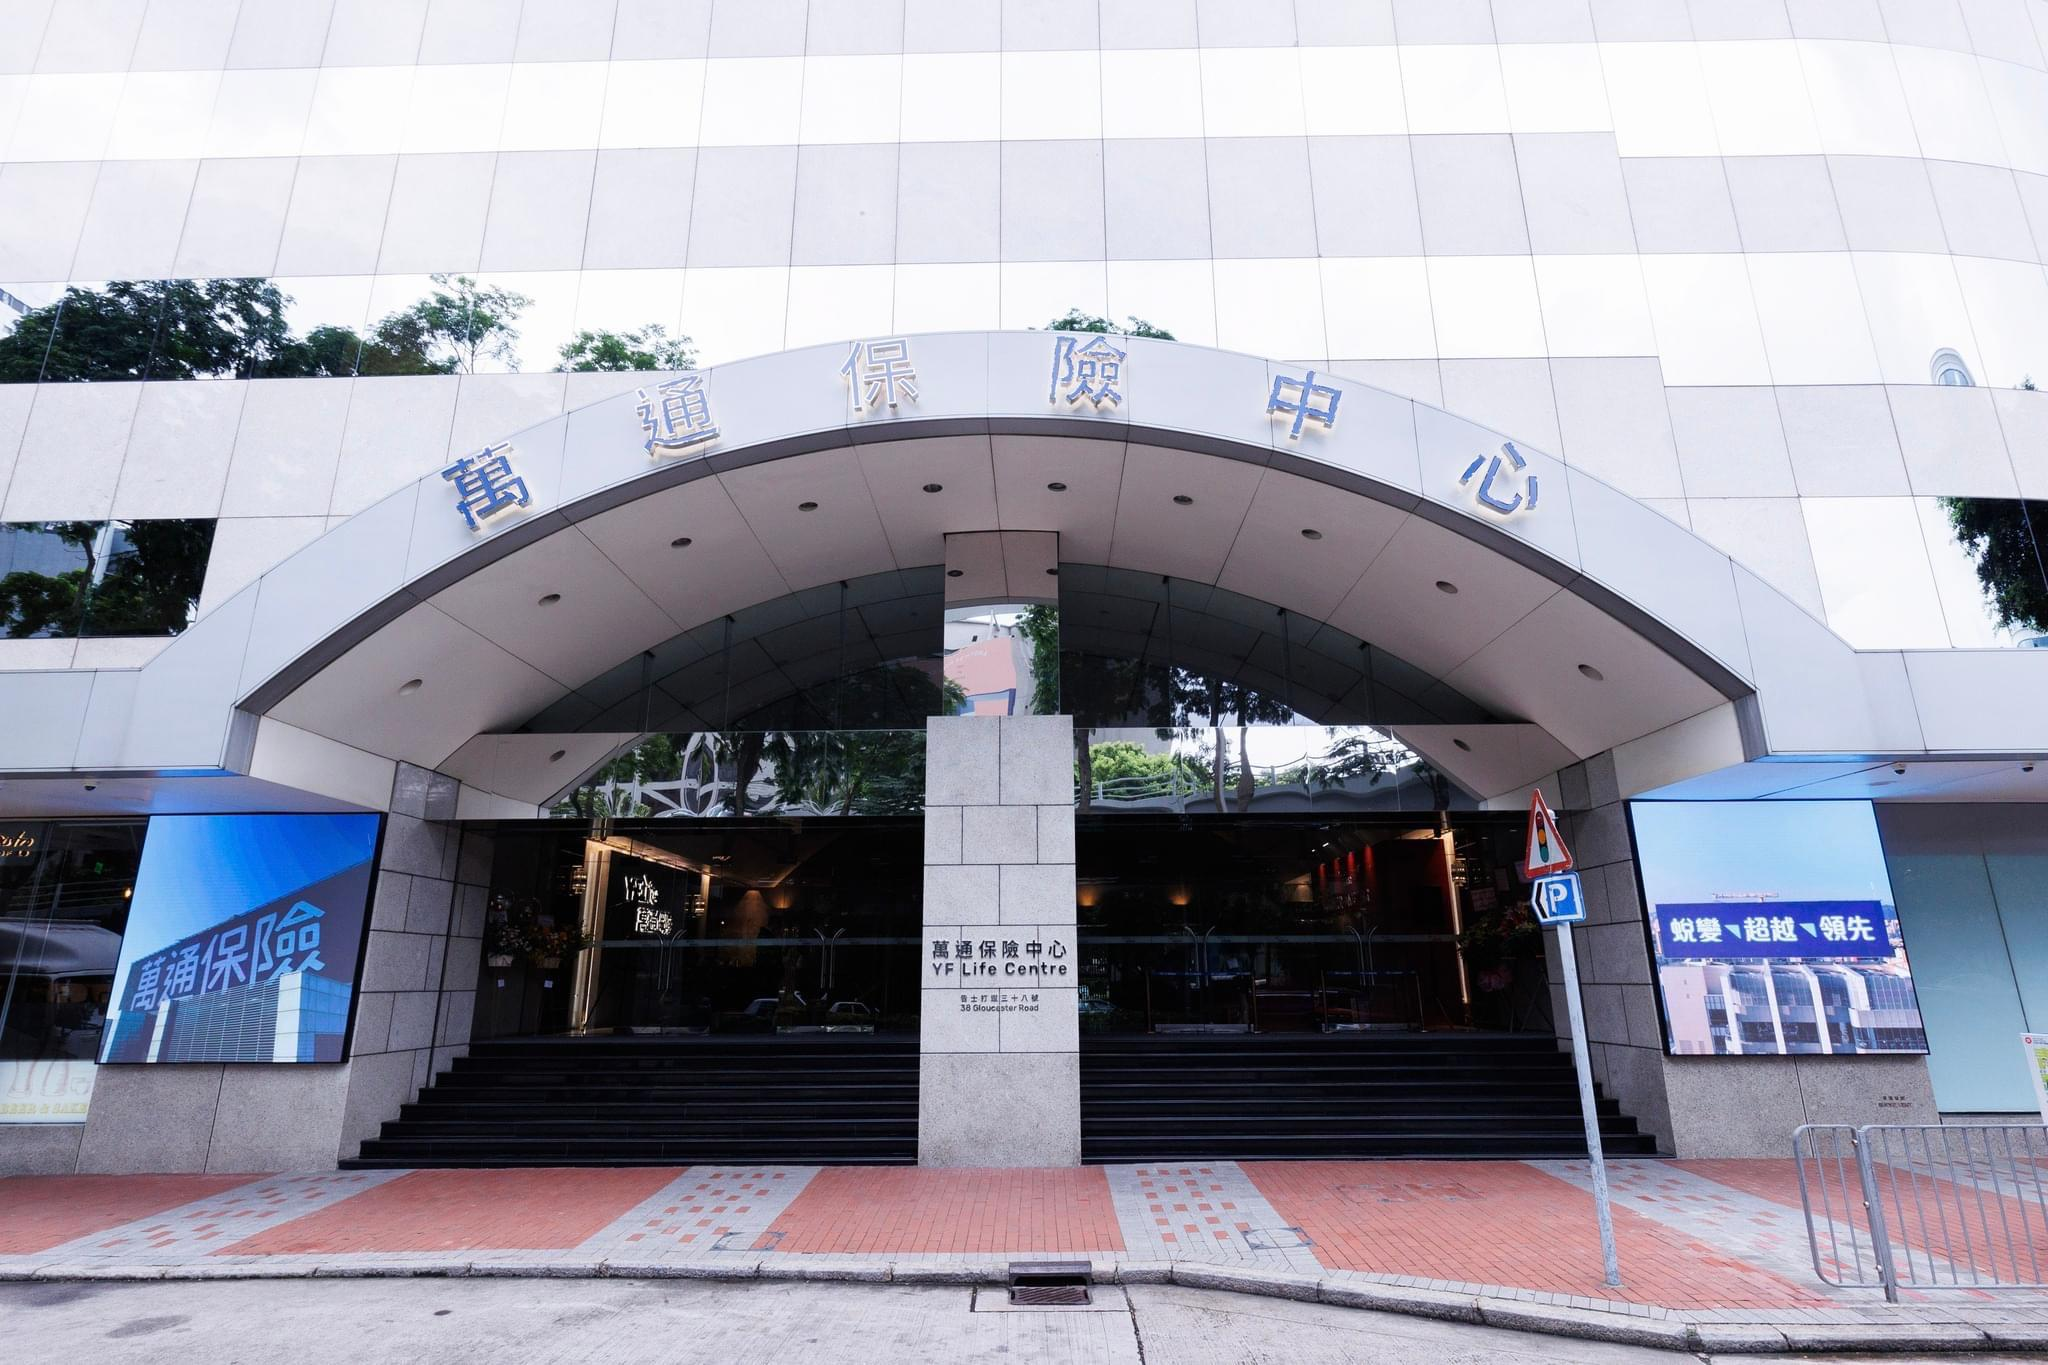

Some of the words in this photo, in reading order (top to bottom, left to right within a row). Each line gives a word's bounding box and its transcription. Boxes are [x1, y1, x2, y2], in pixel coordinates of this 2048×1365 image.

[442, 336, 1538, 532] 萬通保險中心
[1548, 883, 1568, 913] P
[1670, 917, 1722, 942] 蛻變
[1743, 916, 1798, 942] 超越
[1819, 915, 1875, 941] 領先
[130, 900, 326, 1012] 萬通保險
[932, 939, 1067, 959] 萬通保險中心
[932, 962, 954, 976] YF
[962, 961, 997, 976] Life
[1005, 962, 1067, 976] Centre
[960, 1004, 971, 1012] 38
[973, 1004, 1017, 1012] Gloucester
[1019, 1004, 1039, 1012] Road
